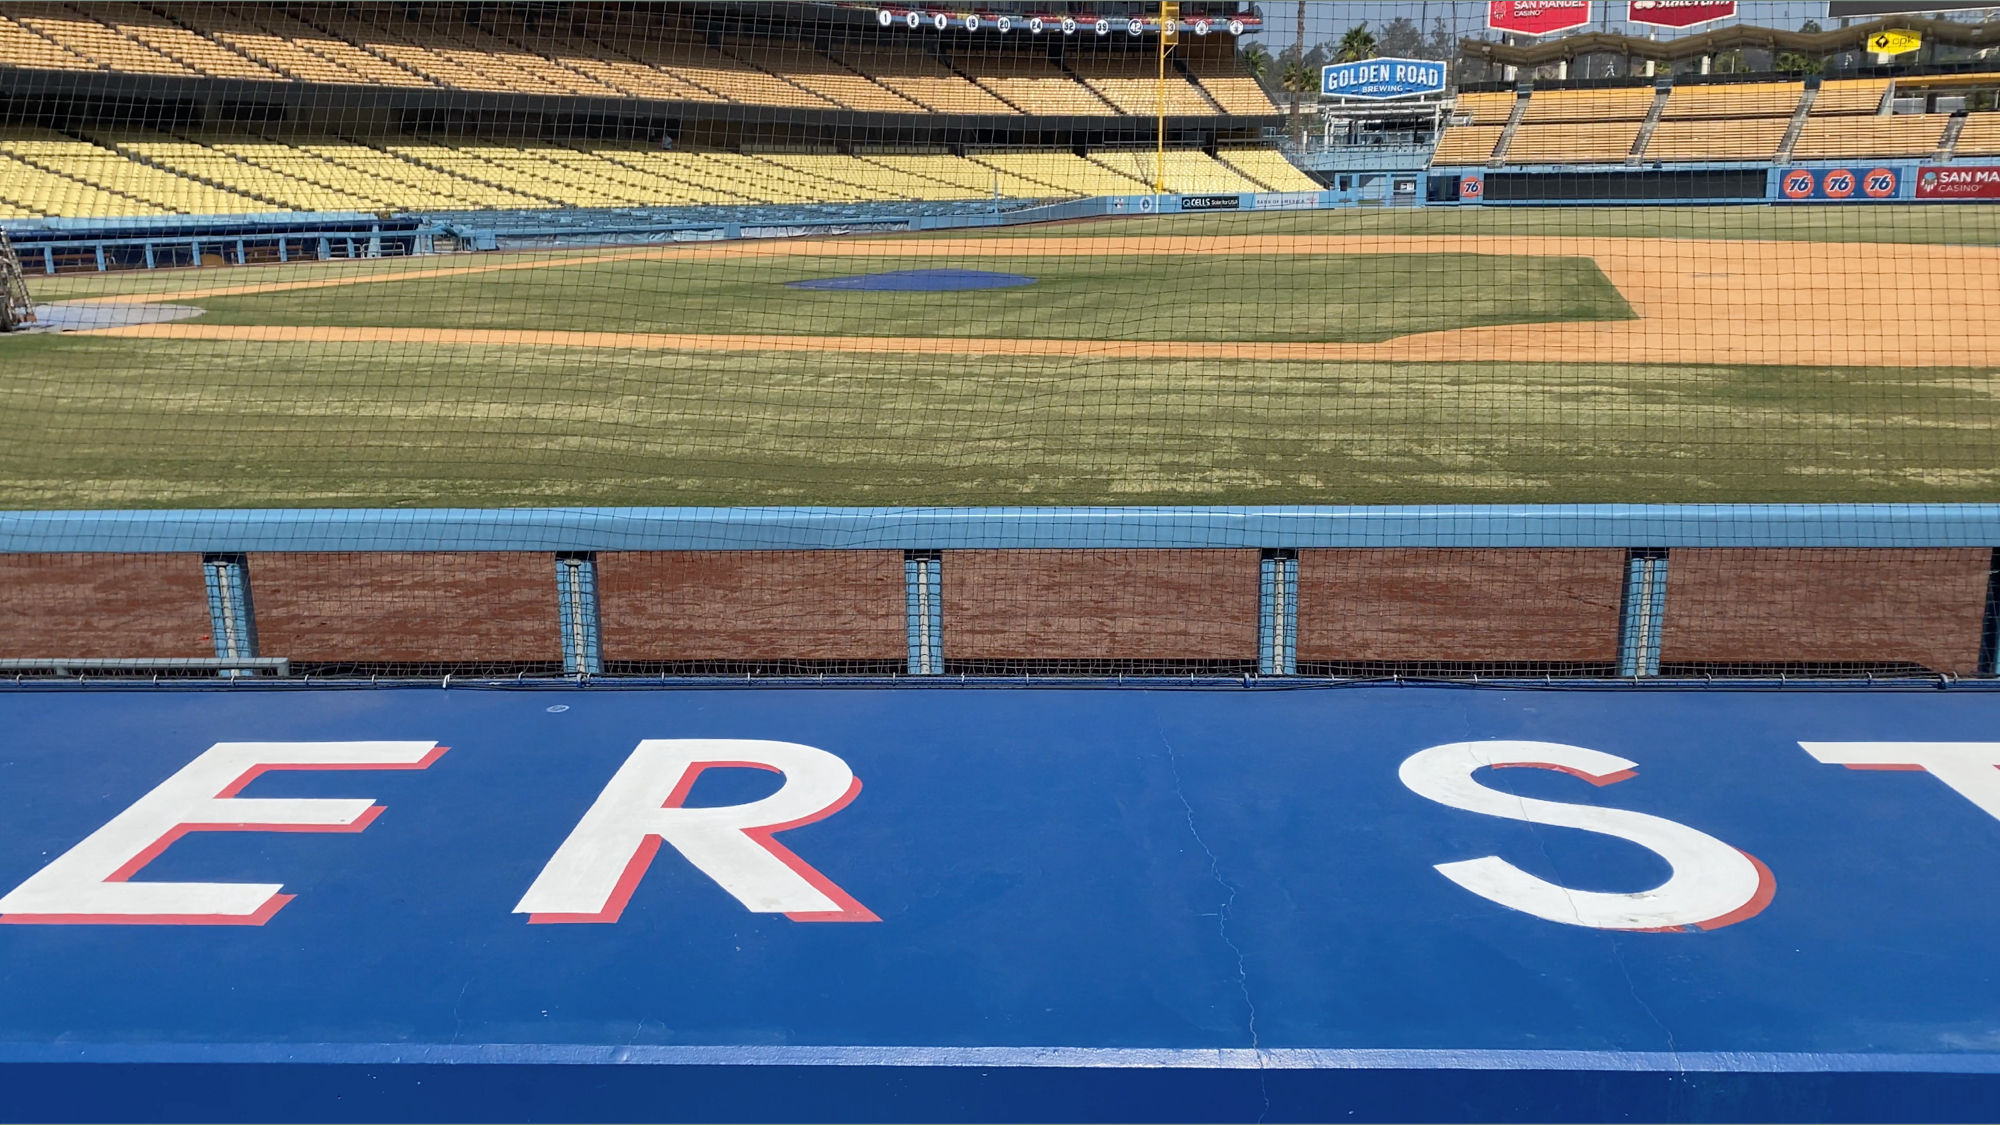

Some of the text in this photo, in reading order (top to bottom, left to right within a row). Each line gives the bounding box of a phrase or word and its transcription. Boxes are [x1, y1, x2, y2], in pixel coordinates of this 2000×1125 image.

[1514, 1, 1536, 10] SAN
[1514, 9, 1541, 17] CASINO
[1328, 64, 1439, 90] GOLDEN ROAD
[1361, 85, 1404, 93] BREWING
[1828, 174, 1852, 192] 76
[1868, 174, 1892, 192] 76
[1940, 171, 1972, 183] SAN
[1464, 181, 1479, 193] 76
[1787, 175, 1811, 192] 76
[1938, 184, 1979, 192] CASINO
[0, 739, 882, 926] ER
